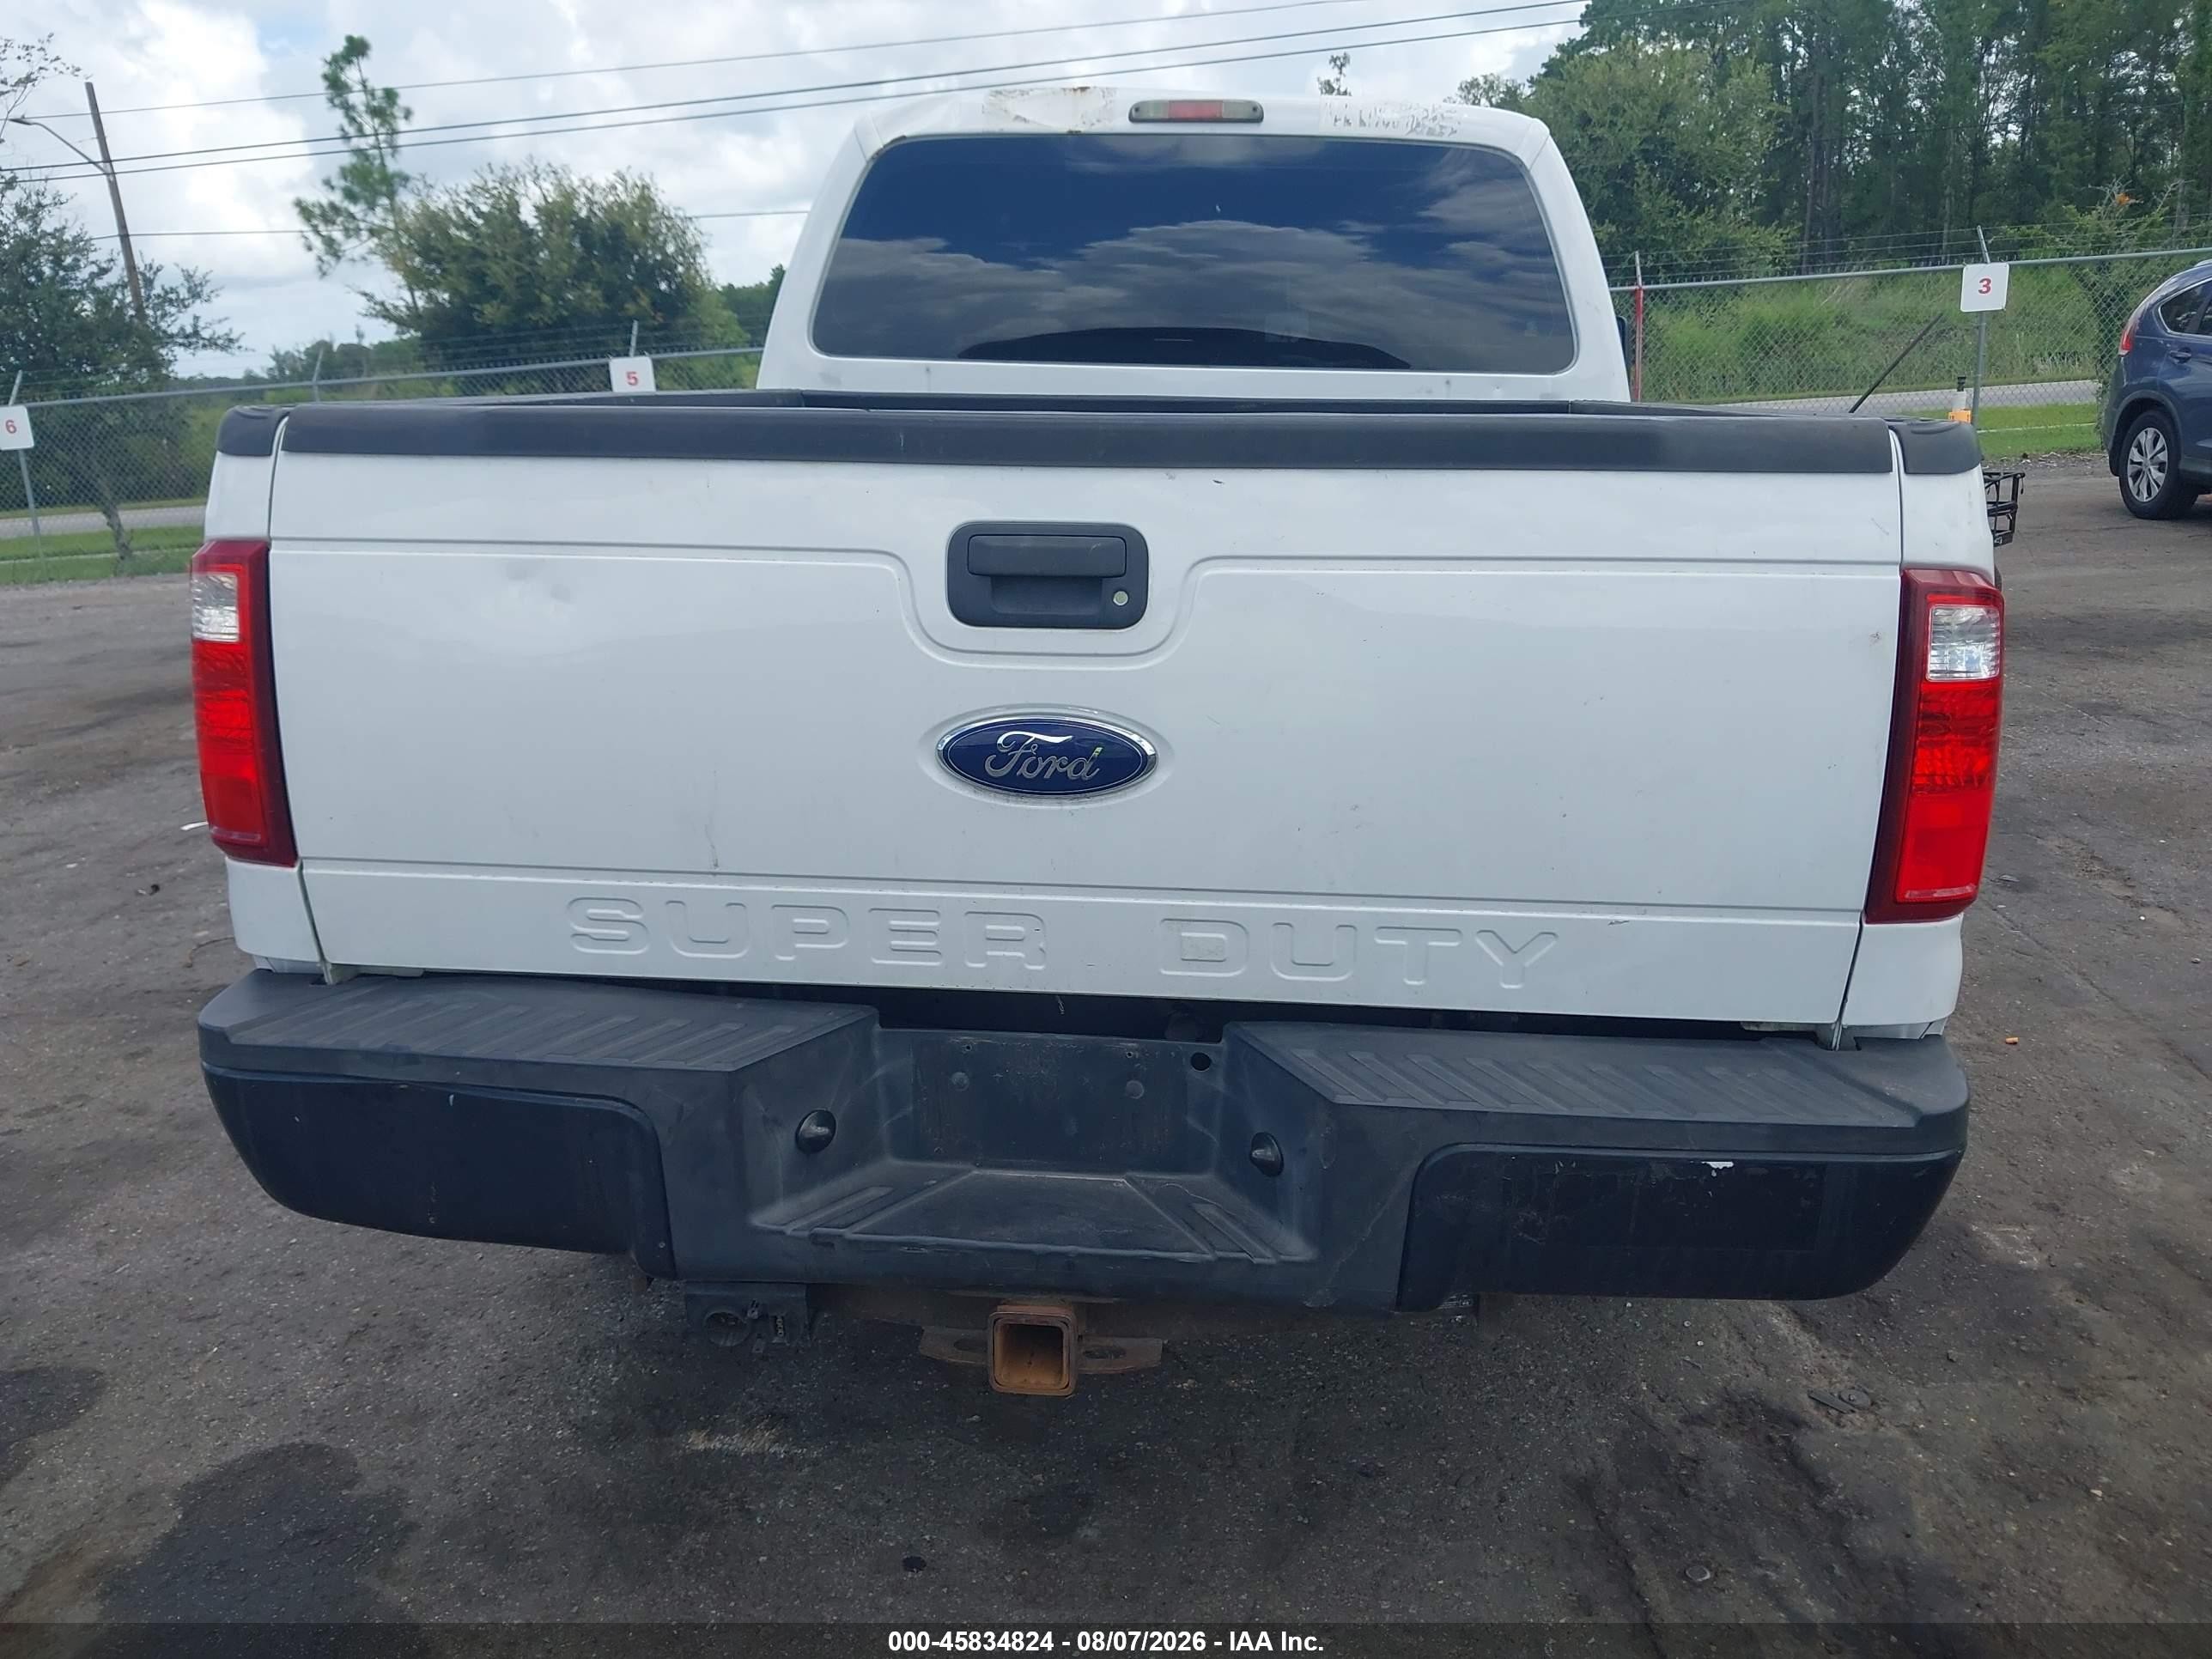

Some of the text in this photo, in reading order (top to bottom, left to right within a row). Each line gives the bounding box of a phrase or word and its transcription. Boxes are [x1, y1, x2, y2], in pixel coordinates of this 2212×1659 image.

[1978, 277, 1992, 295] 3
[626, 371, 639, 386] 5
[5, 419, 17, 434] 6
[984, 730, 1104, 781] Ford
[567, 896, 1559, 989] SUPER DUTY
